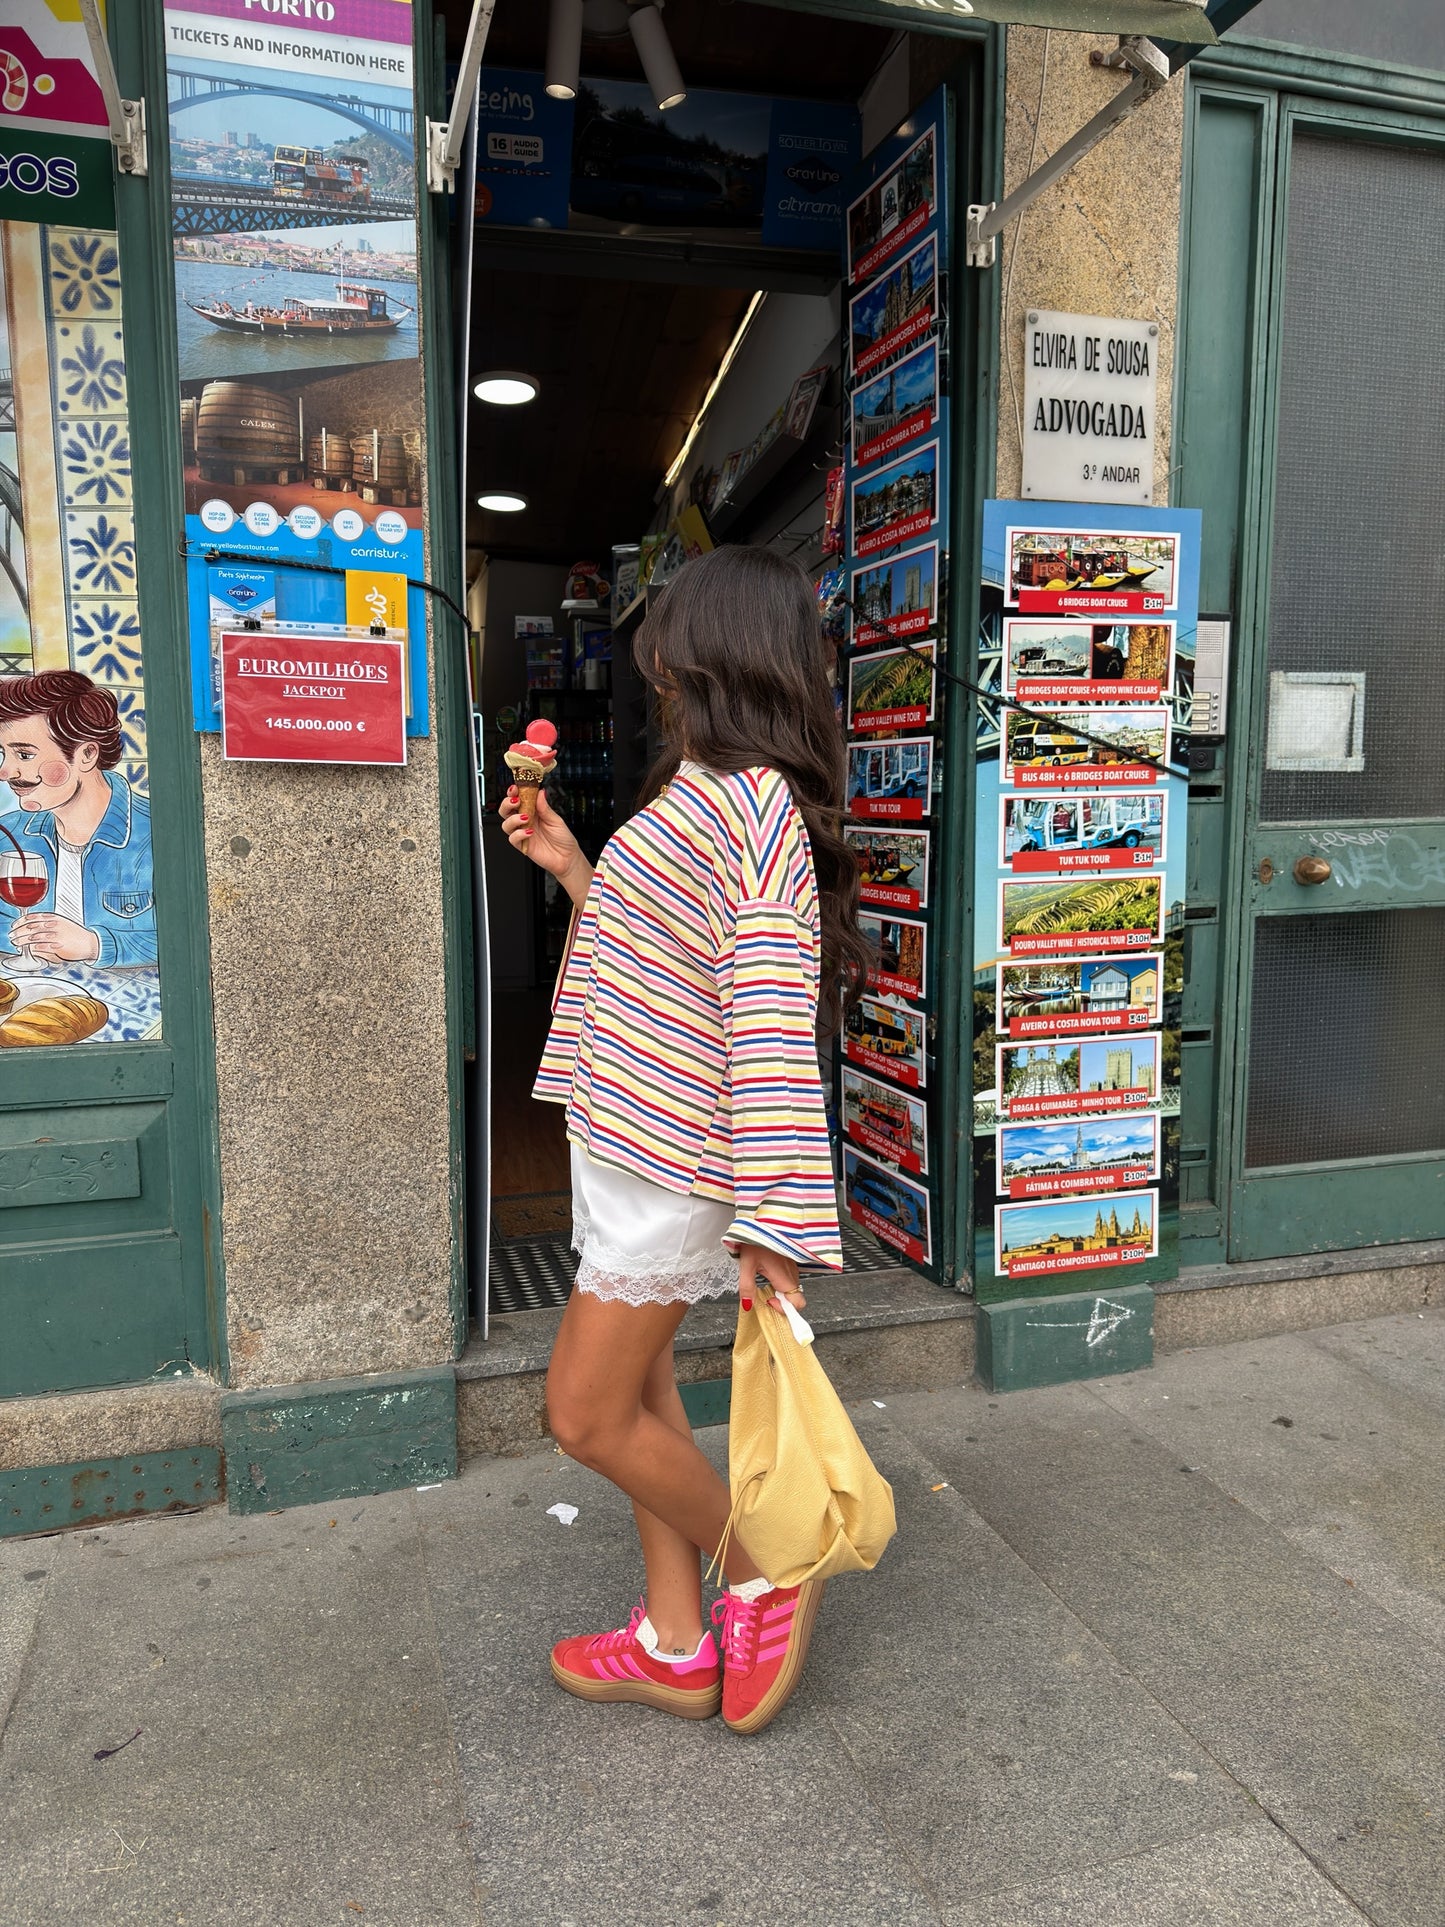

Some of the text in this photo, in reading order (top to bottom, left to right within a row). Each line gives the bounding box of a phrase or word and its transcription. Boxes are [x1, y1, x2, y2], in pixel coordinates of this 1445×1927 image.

[170, 26, 405, 72] TICKETS AND INFORMATION HERE
[492, 138, 506, 149] 16
[514, 140, 539, 148] AUDIO
[0, 153, 79, 198] OS
[917, 314, 929, 328] TOUR
[1034, 332, 1149, 376] ELVIRA DE SOUSA
[1034, 398, 1146, 439] ADVOGADA
[910, 420, 924, 434] TOUR
[1102, 466, 1140, 483] ANDAR
[915, 516, 929, 530] TOUR
[200, 542, 279, 551] www.yellowbustours.com
[351, 548, 399, 558] carristur
[1058, 597, 1062, 606] 6
[1064, 598, 1089, 606] BRIDGES
[1090, 598, 1106, 606] BOAT
[1106, 599, 1128, 607] CRUISE
[238, 658, 388, 681] EUROMILHÕES
[283, 684, 346, 697] JACKPOT
[1019, 687, 1024, 695] 6
[1025, 687, 1051, 695] BRIDGES
[1052, 686, 1068, 694] BOAT
[1069, 686, 1090, 694] CRUISE
[1097, 686, 1117, 694] PORTO
[1118, 686, 1133, 694] WINE
[1134, 686, 1158, 694] CELLARS
[266, 717, 366, 732] 145.000.000 €
[875, 714, 892, 726] VALLEY
[893, 713, 906, 724] WINE
[907, 712, 921, 722] TOUR
[1022, 773, 1038, 782] BUS
[1039, 772, 1055, 782] 48H
[1064, 772, 1069, 781] 6
[1071, 771, 1103, 781] BRIDGES
[1104, 771, 1124, 780] BOAT
[1125, 770, 1150, 779] CRUISE
[869, 803, 901, 813] TUK TUK TOUR
[1059, 856, 1074, 865] TUK
[1075, 855, 1089, 865] TUK
[1090, 854, 1110, 864] TOUR
[880, 890, 892, 901] BOAT
[893, 892, 911, 904] CRUISE
[1014, 940, 1036, 950] DOURO
[1036, 939, 1057, 949] VALLEY
[1057, 938, 1073, 948] WINE
[1078, 936, 1109, 947] HISTORICAL
[1109, 935, 1125, 945] TOUR
[1135, 934, 1150, 943] 10H
[1020, 1013, 1147, 1031] AVEIRO & COSTA NOVA TOUR 4H
[1012, 1104, 1034, 1113] BRAGA
[1035, 1103, 1040, 1111] &
[1041, 1100, 1077, 1111] GUIMARÃES
[1082, 1098, 1104, 1107] MINHO
[1105, 1096, 1122, 1106] TOUR
[1132, 1093, 1146, 1102] 10H
[1026, 1171, 1146, 1193] FÁTIMA & COIMBRA TOUR 10H
[1012, 1249, 1144, 1273] SANTIAGO DE COMPOSTELA TOUR 10H
